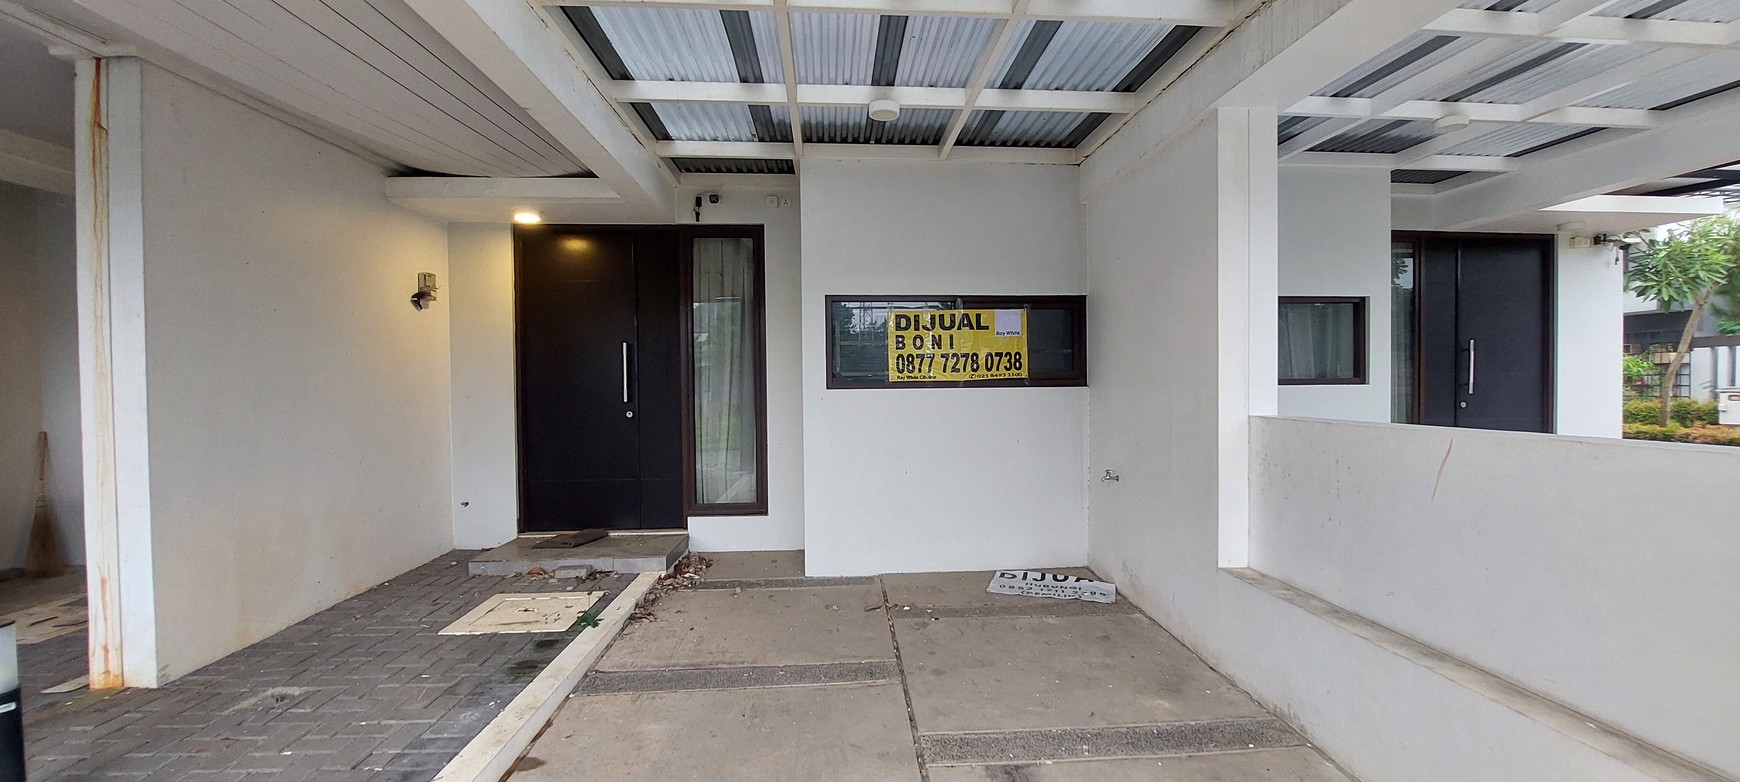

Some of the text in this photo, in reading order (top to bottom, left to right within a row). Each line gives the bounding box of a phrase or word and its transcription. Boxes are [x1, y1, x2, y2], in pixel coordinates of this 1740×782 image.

[895, 313, 990, 331] DIJUAL
[896, 351, 1023, 374] 0877 7278 0738
